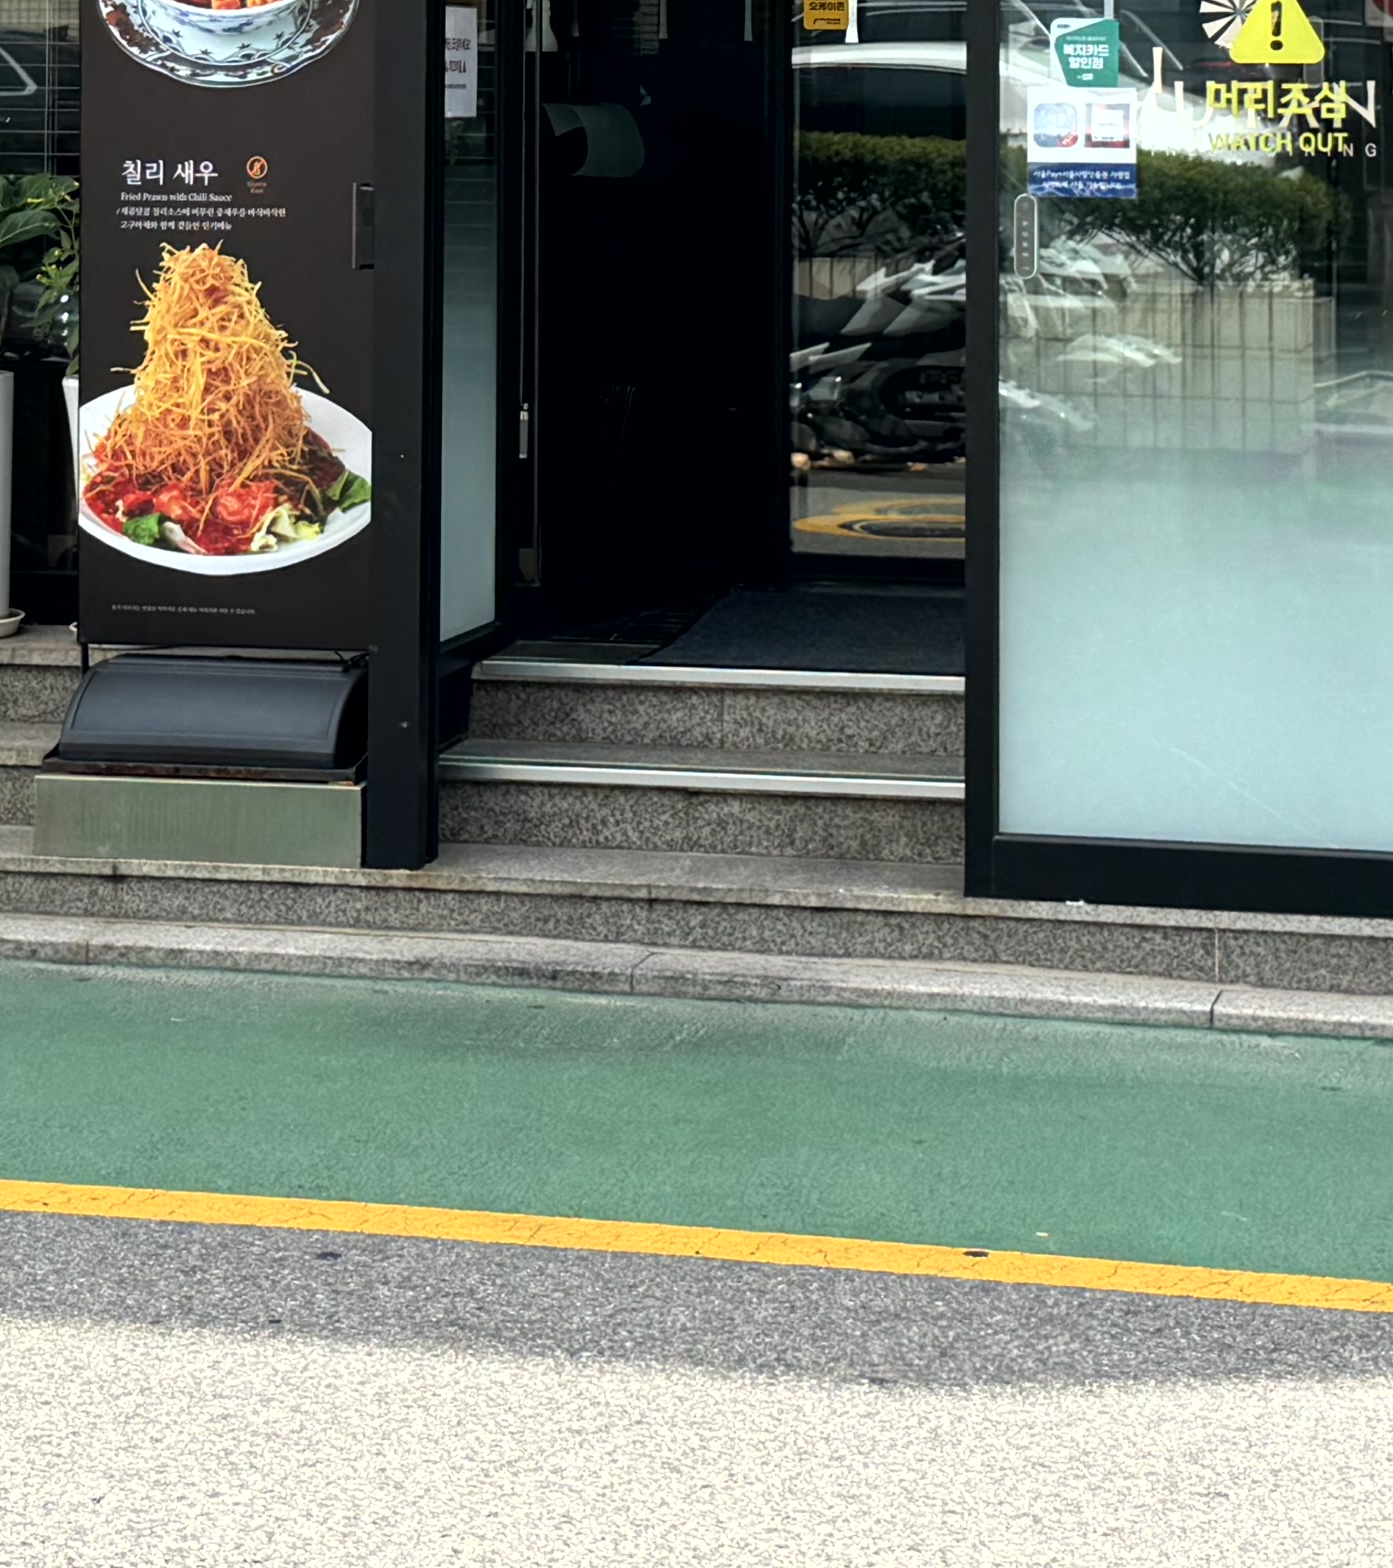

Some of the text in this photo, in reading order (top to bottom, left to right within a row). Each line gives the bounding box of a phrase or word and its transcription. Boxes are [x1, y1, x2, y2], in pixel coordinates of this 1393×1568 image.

[1063, 44, 1109, 57] 복지카드
[1069, 57, 1103, 69] 할인점
[1206, 80, 1347, 118] 머리조심
[1209, 133, 1292, 153] WATCH
[121, 160, 218, 185] 칠리 새우
[121, 192, 141, 201] Fried
[169, 192, 187, 201] with
